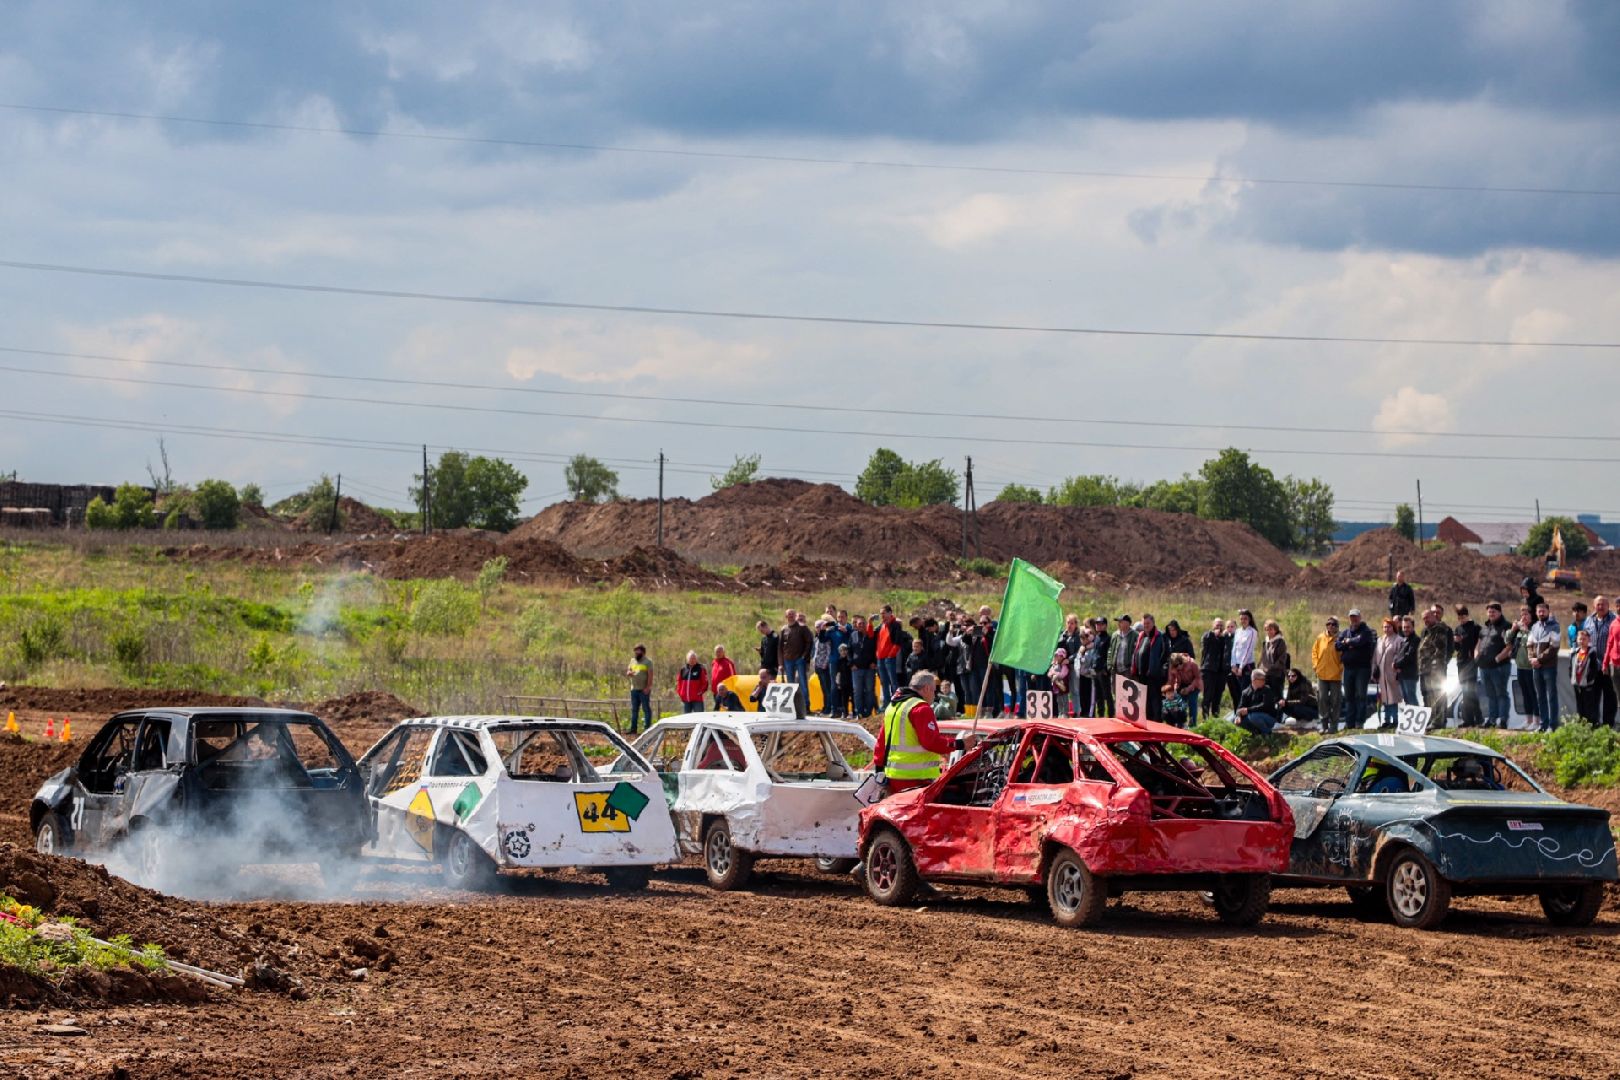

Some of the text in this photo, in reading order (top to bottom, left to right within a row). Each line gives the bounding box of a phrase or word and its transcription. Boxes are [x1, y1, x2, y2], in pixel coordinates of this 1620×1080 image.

[766, 686, 793, 713] 52
[1027, 691, 1051, 719] 33
[1122, 680, 1139, 722] 3
[1399, 708, 1428, 733] 39
[71, 797, 85, 830] 21
[583, 802, 618, 822] 44
